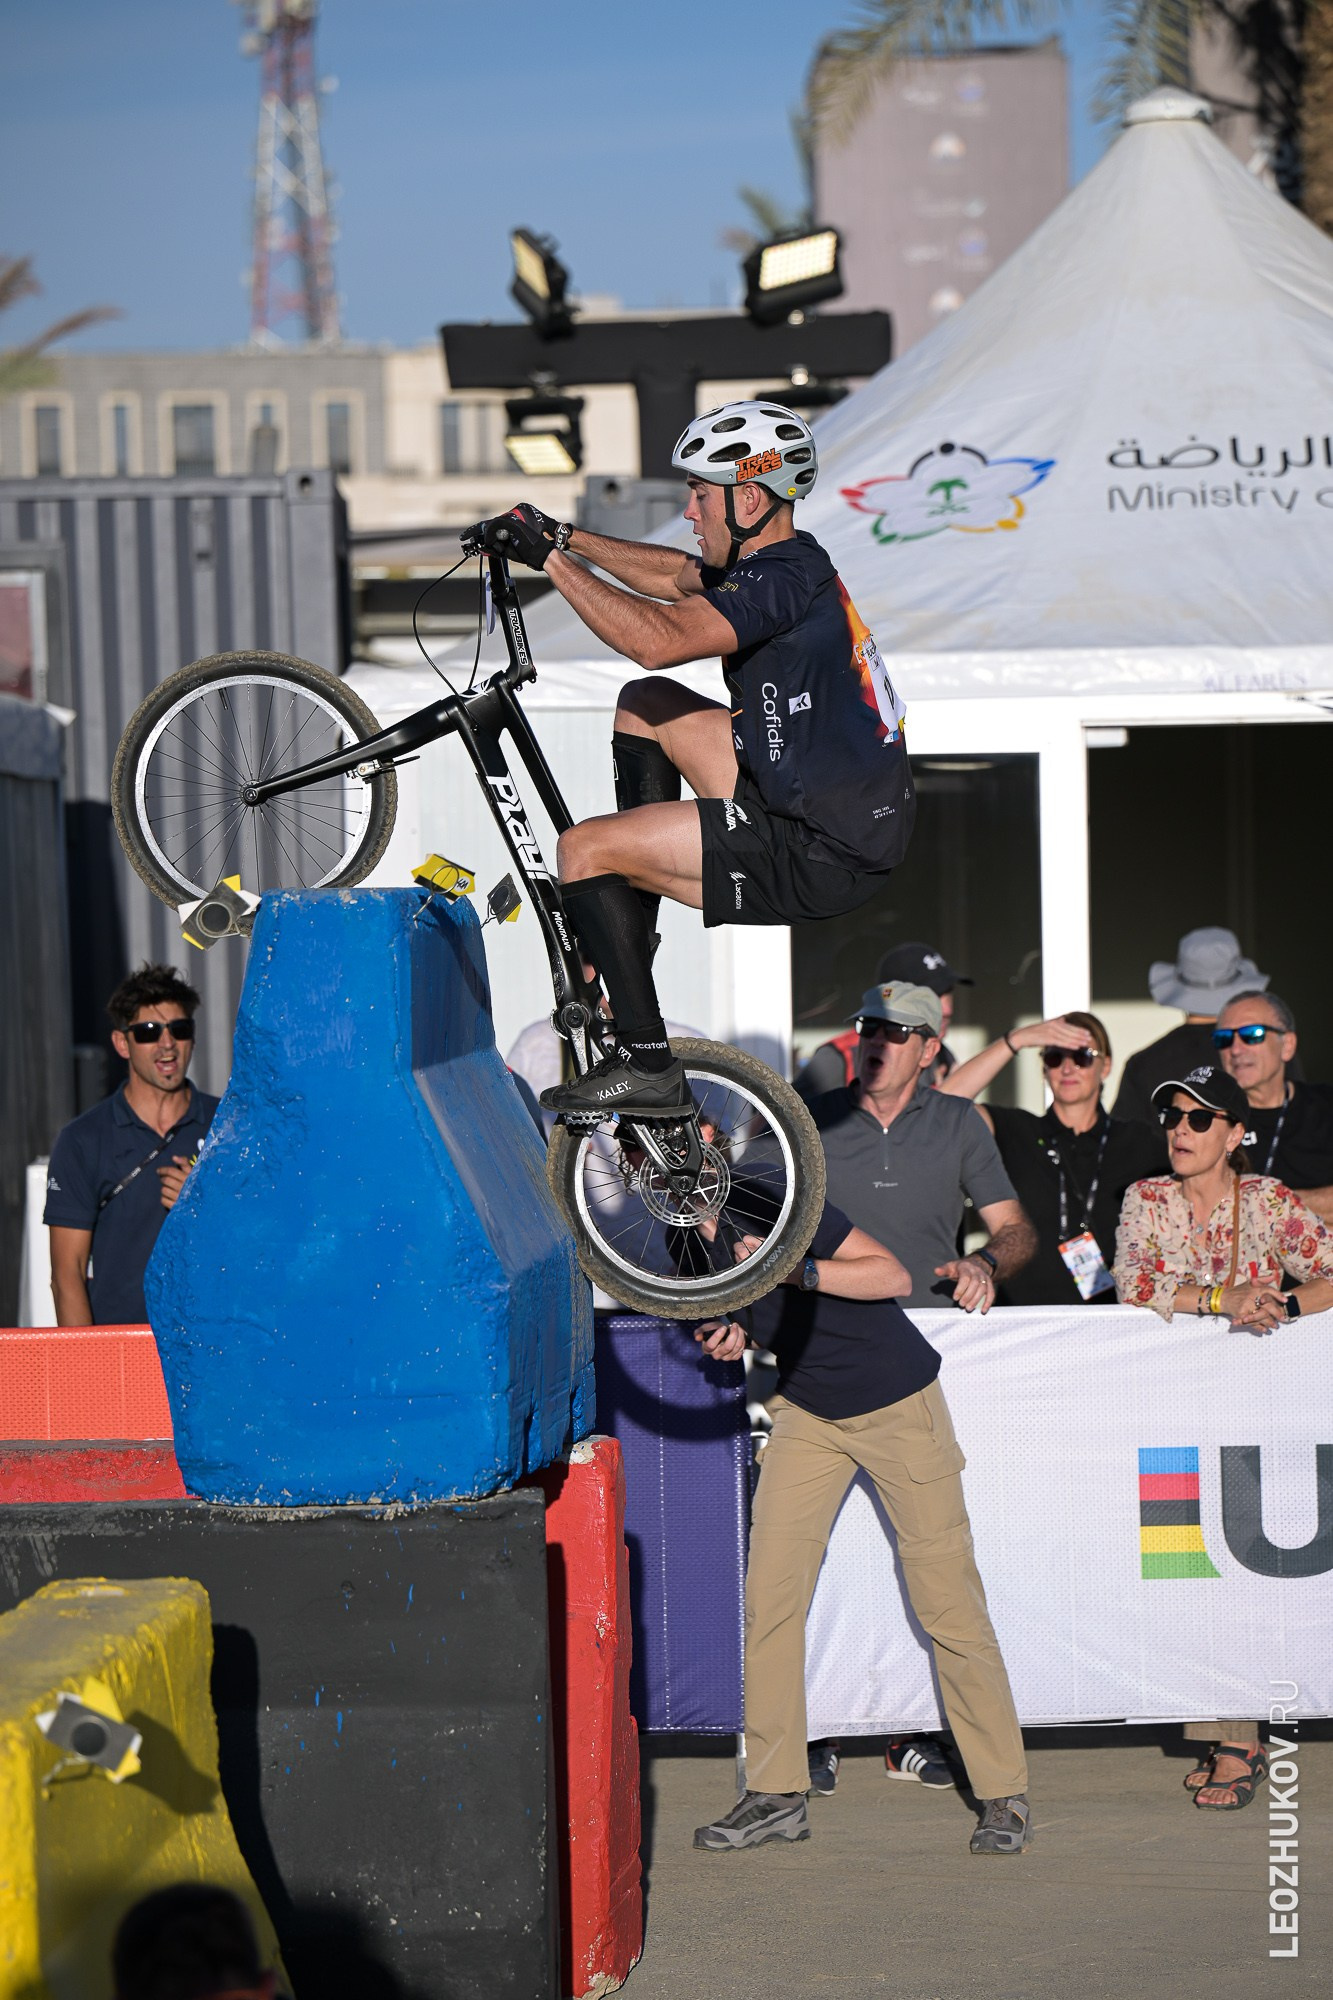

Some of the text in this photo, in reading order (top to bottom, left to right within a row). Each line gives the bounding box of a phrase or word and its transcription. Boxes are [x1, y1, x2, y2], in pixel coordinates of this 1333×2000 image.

[735, 448, 781, 471] TRIAL
[736, 458, 782, 483] BIKES
[1107, 435, 1333, 478] الرياضة
[1108, 481, 1299, 512] Ministry
[762, 682, 784, 761] Cofidis
